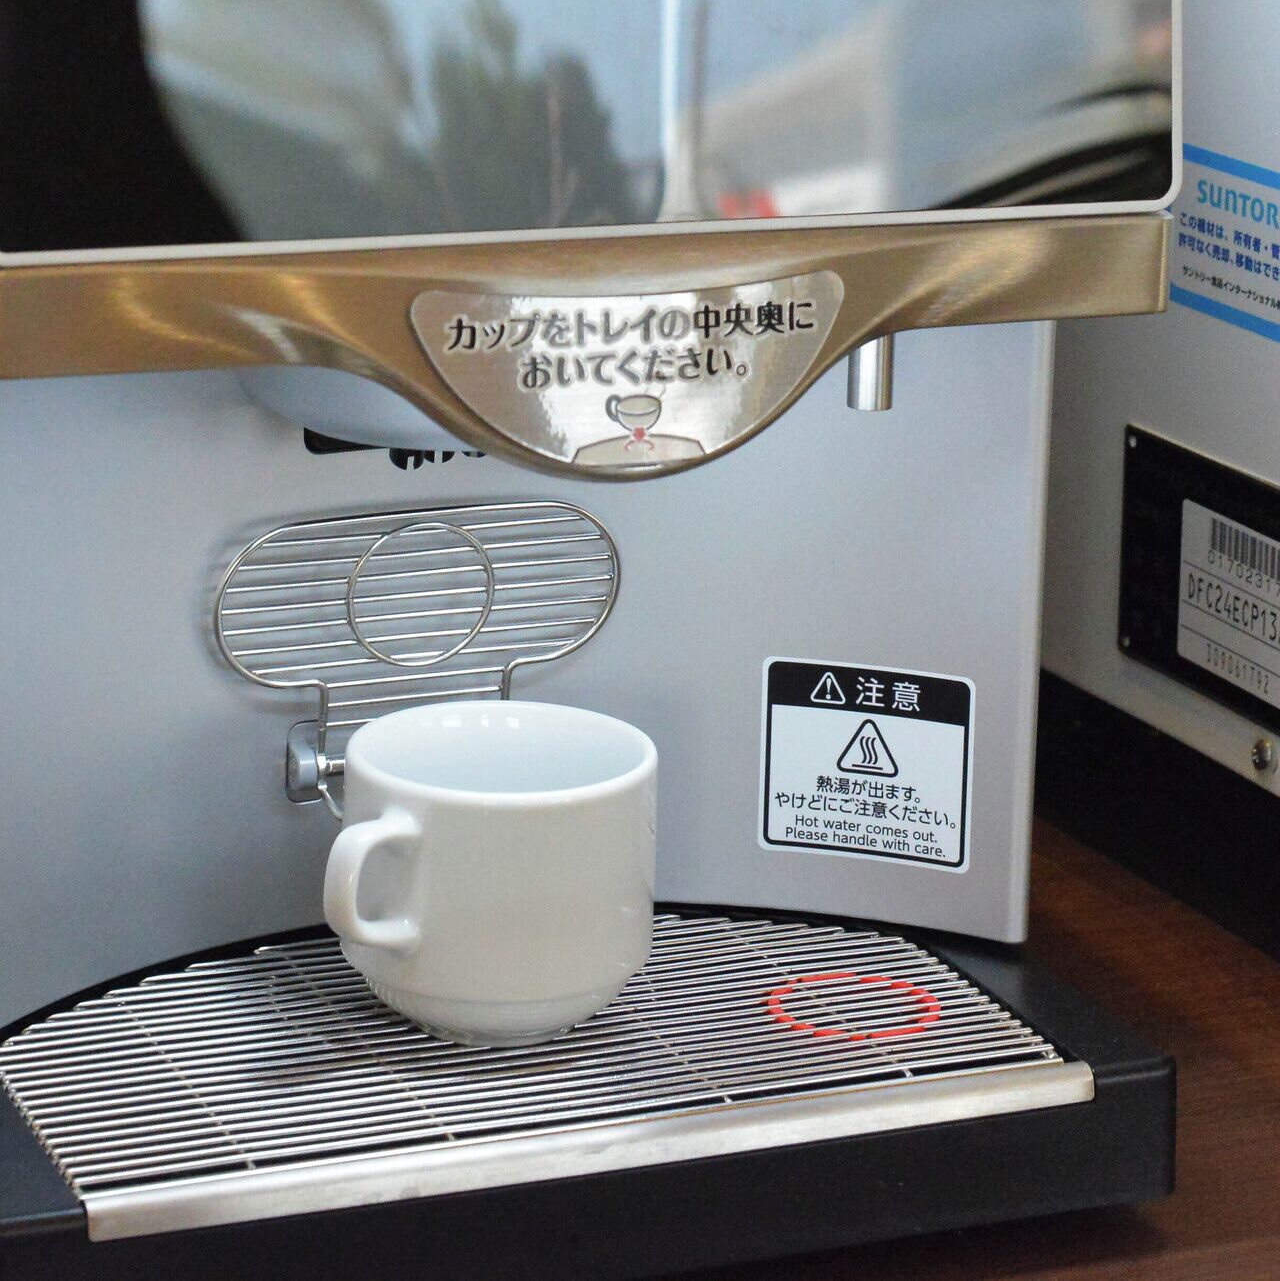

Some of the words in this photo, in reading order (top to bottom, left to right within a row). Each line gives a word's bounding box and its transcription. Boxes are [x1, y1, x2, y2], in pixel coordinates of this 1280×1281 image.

[447, 301, 814, 351] カップをトレイの中央奥に
[521, 347, 747, 390] おいてください。
[855, 676, 922, 712] 注意
[816, 775, 921, 804] 熱湯が出ます。
[775, 791, 957, 829] やけどにご注意ください。
[785, 826, 828, 842] Please
[832, 831, 878, 848] handle
[882, 838, 910, 853] with
[914, 841, 946, 858] care.
[795, 815, 819, 828] Hot
[823, 819, 861, 833] water
[866, 824, 909, 839] comes
[912, 828, 938, 844] out.
